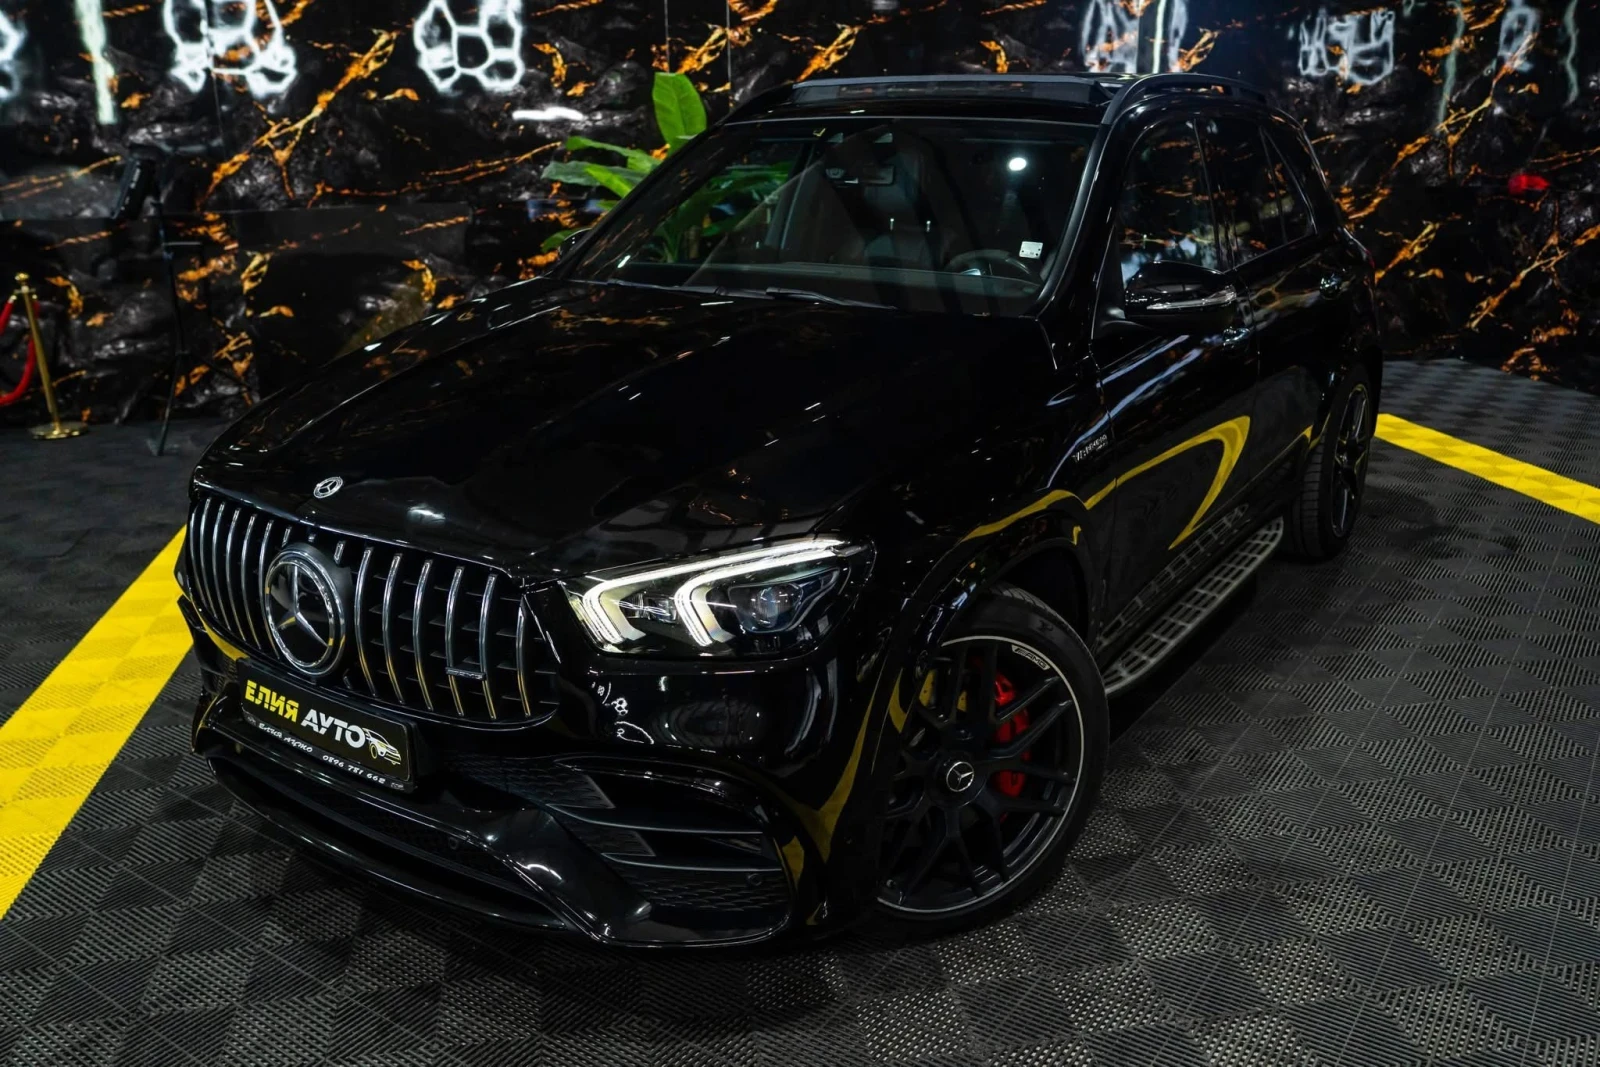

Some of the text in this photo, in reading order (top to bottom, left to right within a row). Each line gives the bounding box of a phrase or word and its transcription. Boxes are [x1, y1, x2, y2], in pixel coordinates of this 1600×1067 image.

[245, 679, 366, 749] ЕЛИЯ АУТО
[322, 754, 344, 769] 0896
